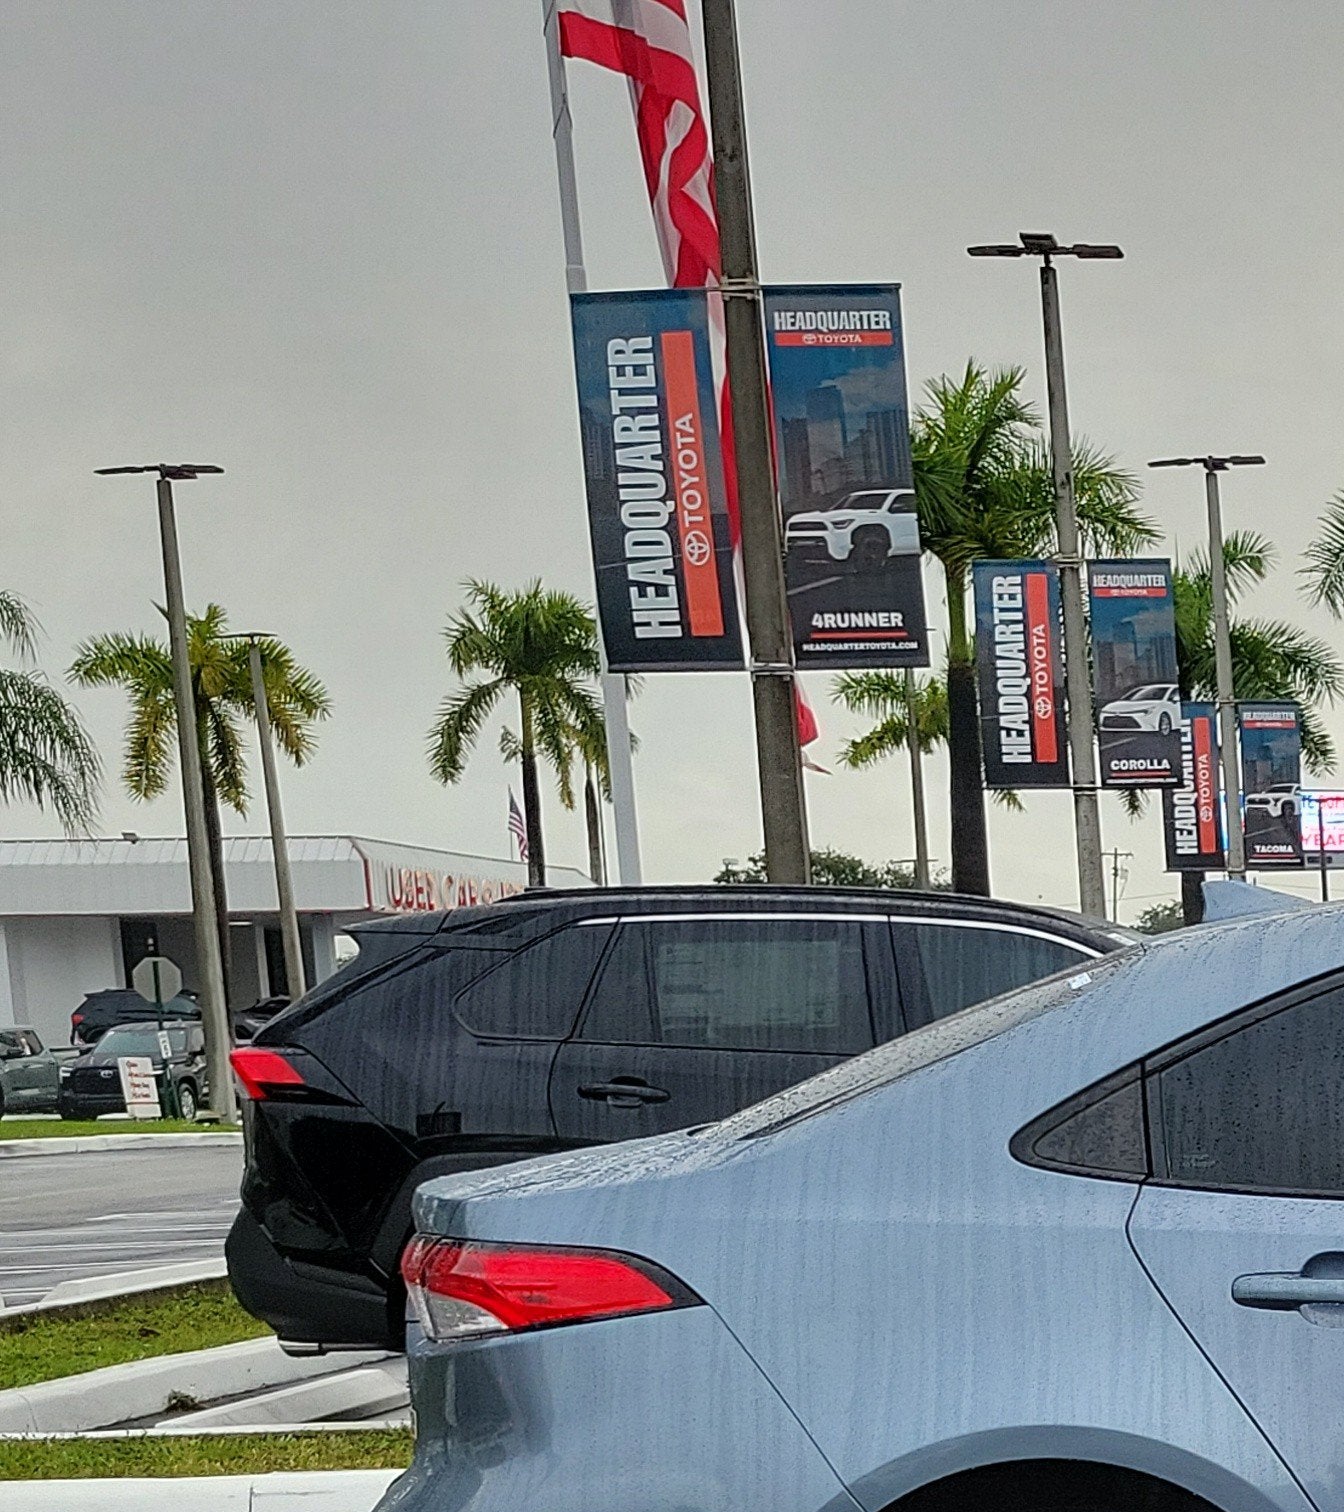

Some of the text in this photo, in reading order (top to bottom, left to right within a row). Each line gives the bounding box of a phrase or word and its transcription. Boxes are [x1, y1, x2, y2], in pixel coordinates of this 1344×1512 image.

[774, 310, 891, 331] HEADQUARTER
[818, 334, 862, 345] TOYOTA
[676, 412, 701, 528] TOYOTA
[607, 335, 683, 640] HEADQUARTER
[1093, 574, 1166, 589] HEADQUARTER
[811, 611, 904, 630] 4RUNNER
[992, 575, 1033, 764] HEADQUARTER
[1032, 624, 1050, 696] TOYOTA
[1110, 759, 1171, 771] COROLLA
[1198, 753, 1211, 805] TOYOTA
[1253, 844, 1294, 854] TACOMA
[386, 864, 436, 911] USED
